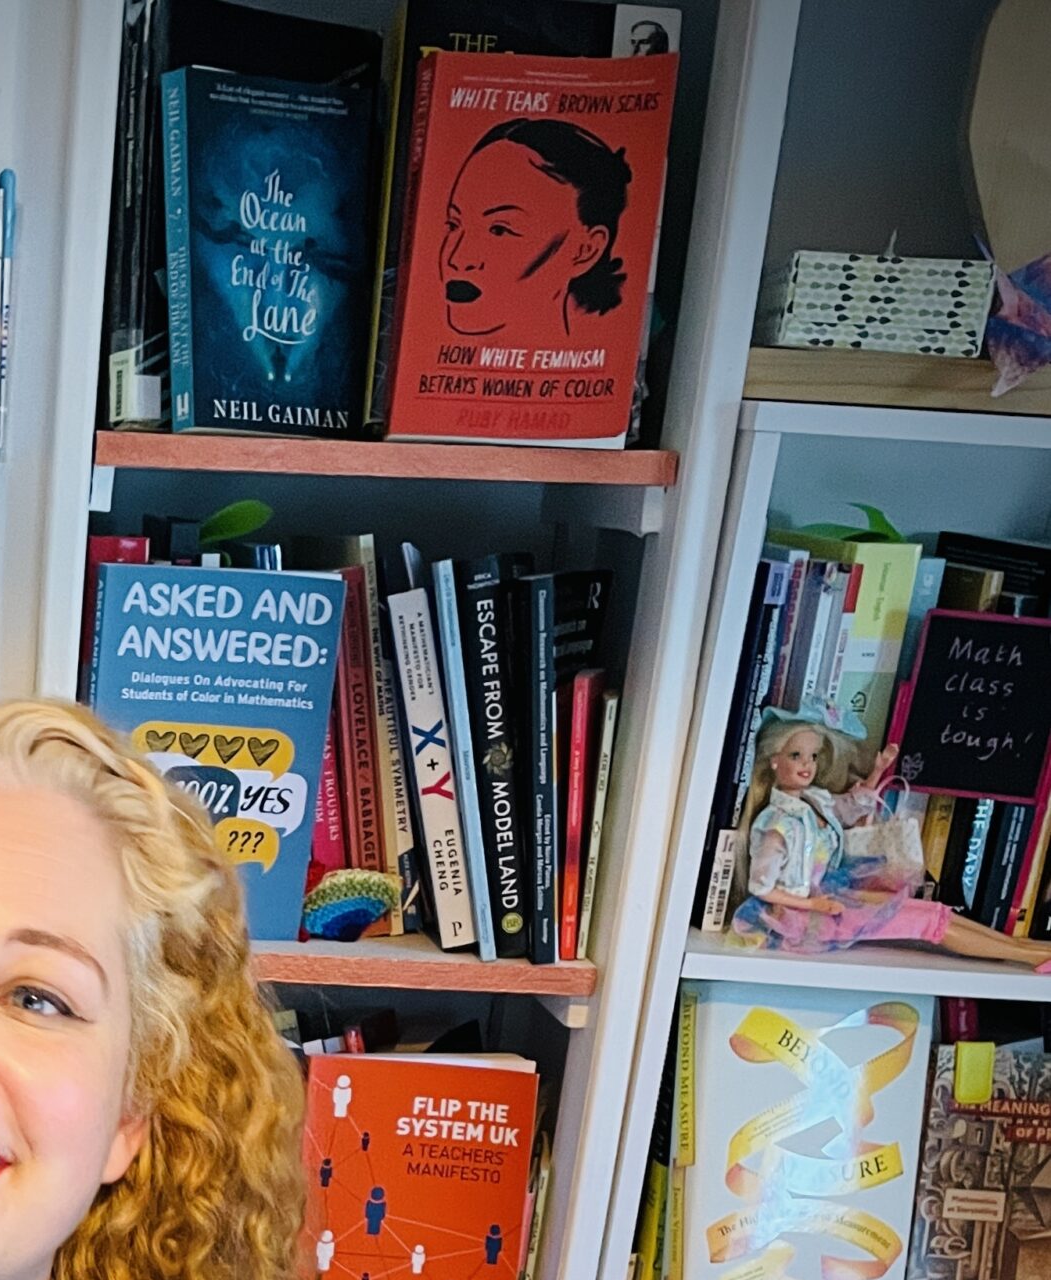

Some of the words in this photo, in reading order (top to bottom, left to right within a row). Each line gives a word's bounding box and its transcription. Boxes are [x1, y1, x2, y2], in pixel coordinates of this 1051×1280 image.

[167, 87, 180, 124] NEIL
[450, 88, 501, 110] WHITE
[505, 89, 550, 112] TEARS
[557, 93, 613, 114] BROWN
[616, 92, 662, 113] SCARS
[169, 129, 183, 197] GAIMAN
[261, 168, 293, 207] The
[240, 190, 306, 232] Ocean
[250, 237, 267, 256] at
[231, 255, 270, 290] End
[271, 270, 284, 291] of
[288, 264, 317, 303] The
[243, 289, 317, 344] Lane
[437, 345, 477, 365] HOW
[480, 347, 527, 369] WHITE
[532, 349, 605, 369] FEMINISM
[418, 375, 477, 394] BETRAYS
[482, 379, 534, 397] WOMEN
[540, 380, 558, 397] OF
[564, 378, 614, 397] COLOR
[214, 399, 262, 423] NEIL
[268, 404, 348, 429] GAIMAN
[457, 411, 501, 429] RUBY
[506, 411, 569, 430] HAMAD
[474, 573, 491, 581] ERICA
[122, 581, 243, 618] ASKED
[251, 589, 333, 625] AND
[117, 625, 329, 668] ANSWERED:
[476, 599, 500, 676] ESCAPE
[948, 637, 1022, 666] Math
[398, 615, 410, 667] RETHINKING
[406, 668, 416, 701] GENDER
[409, 623, 421, 664] MANIFESTO
[416, 667, 425, 689] FOR
[418, 620, 435, 695] MATHEMATICIAN'S
[121, 688, 173, 702] Students
[176, 690, 187, 702] of
[190, 691, 221, 703] Color
[223, 692, 235, 704] in
[237, 693, 314, 710] Mathematics
[132, 672, 190, 686] Dialogues
[193, 675, 210, 685] On
[214, 676, 284, 693] Advocating
[288, 680, 308, 693] For
[377, 684, 385, 716] MATHS
[483, 680, 505, 740] FROM
[539, 682, 548, 732] Mathematics
[962, 703, 988, 720] is
[384, 678, 398, 754] BEAUTIFUL
[391, 758, 408, 833] SYMMETRY
[411, 719, 446, 756] X
[539, 733, 548, 747] and
[940, 724, 1033, 760] tough!
[351, 683, 369, 770] LOVELACE
[360, 788, 376, 862] BABBAGE
[426, 758, 438, 771] +
[241, 786, 293, 815] YES
[421, 771, 455, 801] Y
[324, 770, 340, 841] TROUSERS
[492, 782, 514, 852] MODEL
[227, 831, 265, 853] ???
[432, 839, 449, 891] CHENG
[444, 829, 463, 896] EUGENIA
[498, 856, 519, 909] LAND
[681, 1004, 694, 1072] BEYOND
[412, 1096, 461, 1118] FLIP
[467, 1101, 509, 1123] THE
[679, 1075, 690, 1151] MEASURE
[396, 1117, 483, 1142] SYSTEM
[489, 1128, 520, 1147] UK
[403, 1143, 414, 1157] A
[1016, 1128, 1033, 1138] OF
[407, 1162, 501, 1184] MANIFESTO
[718, 1222, 738, 1237] The
[836, 1214, 891, 1250] Measurement
